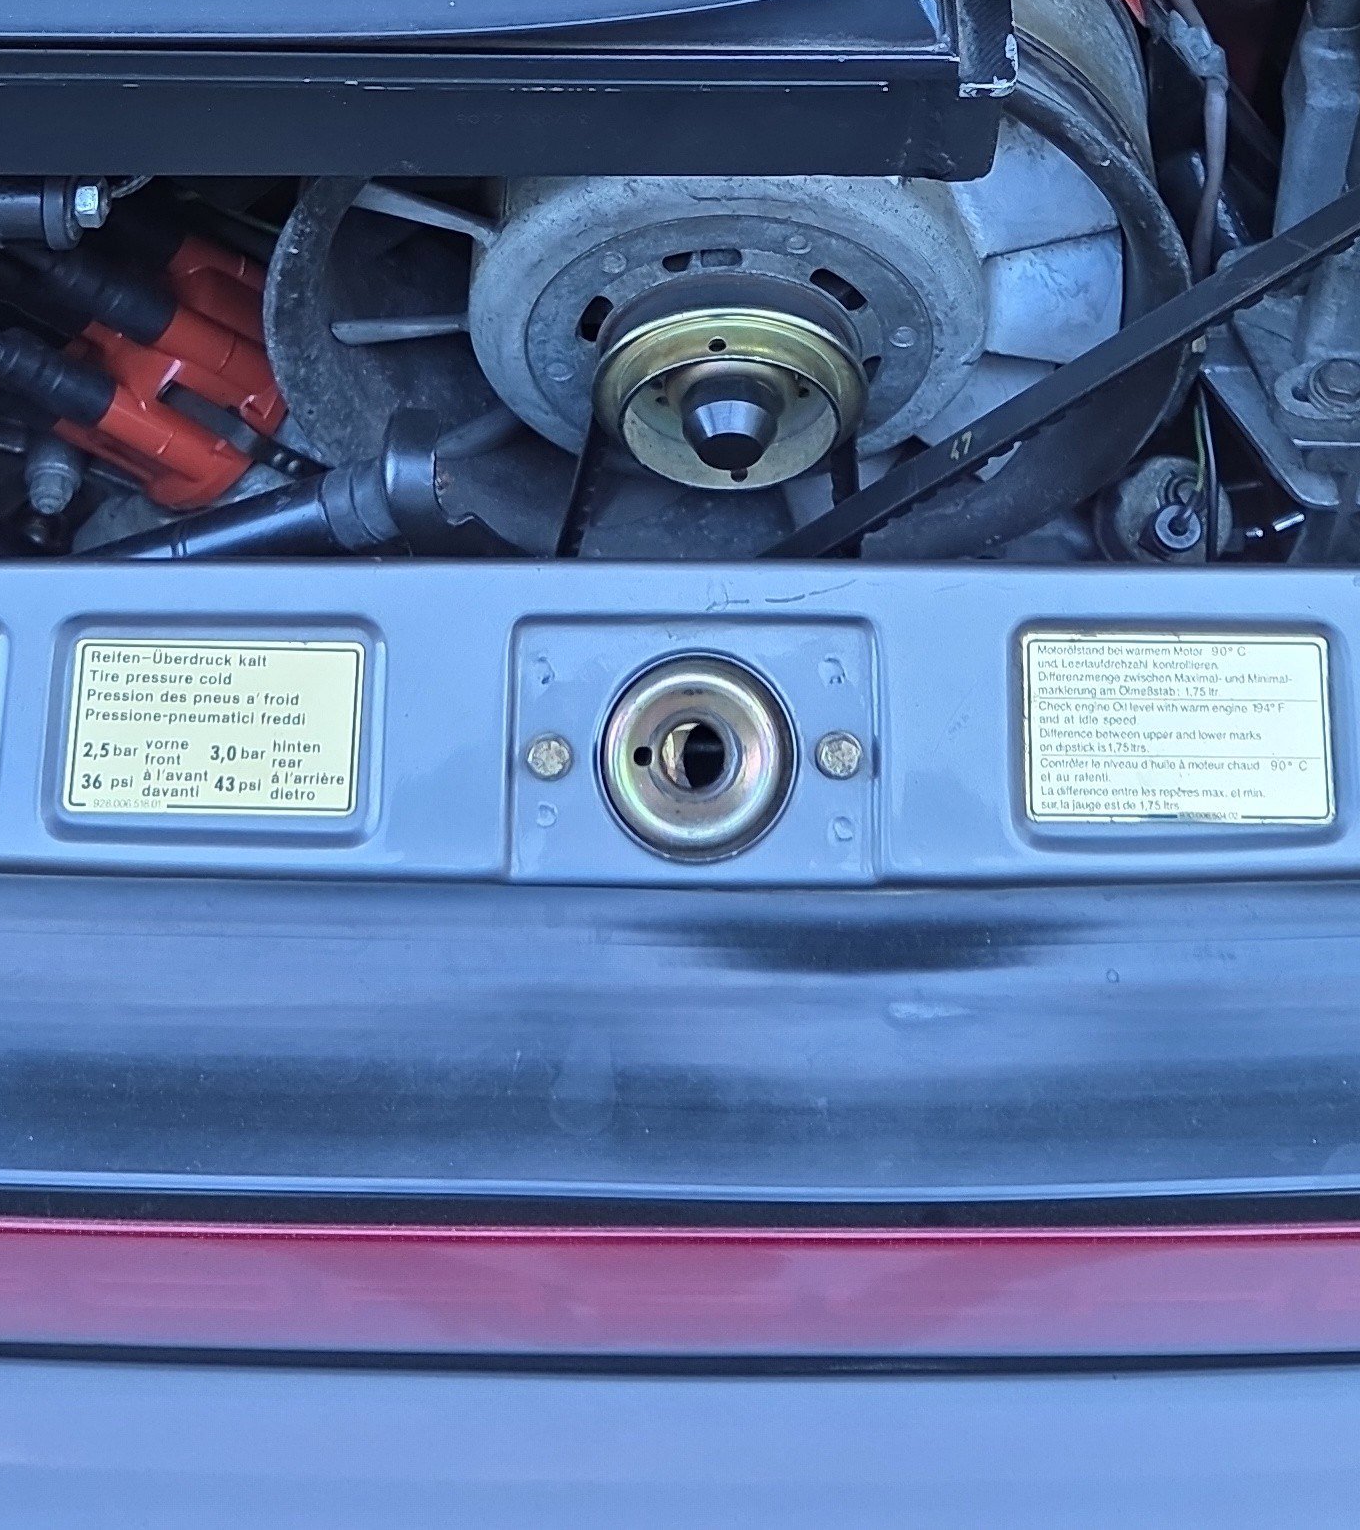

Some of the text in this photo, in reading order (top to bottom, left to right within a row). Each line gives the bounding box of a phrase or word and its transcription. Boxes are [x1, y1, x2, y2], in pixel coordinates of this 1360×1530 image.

[1037, 644, 1105, 655] Motorölstand
[1107, 645, 1123, 655] bei
[1125, 646, 1171, 656] warmem
[1173, 646, 1203, 656] Motor
[1237, 646, 1247, 657] C
[239, 654, 267, 667] kalt
[1037, 658, 1148, 670] und Leerlaufdrehzahl
[89, 669, 232, 686] Tire pressure cold
[1038, 671, 1121, 685] Differenzmenge
[1123, 672, 1172, 683] zwischen
[1225, 673, 1245, 684] und
[87, 688, 154, 702] Pression
[160, 690, 187, 703] des
[193, 693, 240, 706] pneus
[264, 692, 300, 706] froid
[1038, 685, 1097, 698] markierung
[1099, 687, 1116, 696] am
[1038, 700, 1072, 712] Check
[1074, 702, 1110, 714] engine
[1112, 701, 1128, 712] Oil
[1129, 701, 1154, 713] level
[1156, 703, 1178, 713] with
[1180, 704, 1209, 713] warm
[1211, 703, 1248, 716] engine
[1277, 702, 1285, 713] F
[85, 708, 306, 726] Pressione-pneumatici freddi
[1039, 714, 1060, 725] and
[1063, 714, 1075, 725] at
[1079, 714, 1099, 725] idle
[1039, 727, 1262, 741] Difference between upper and lower marks
[82, 741, 138, 760] 2,5 bar
[145, 739, 189, 750] vorne
[272, 739, 321, 753] hinten
[1039, 743, 1053, 753] on
[1055, 742, 1095, 754] dipstick
[1097, 742, 1107, 752] is
[144, 752, 181, 765] front
[210, 744, 266, 764] 3,0 bar
[272, 758, 303, 769] rear
[1091, 758, 1101, 769] le
[1103, 758, 1138, 770] niveau
[1188, 760, 1225, 770] moteur
[1227, 760, 1260, 771] chaud
[1298, 759, 1308, 772] C
[81, 773, 134, 790] 36 psi
[156, 769, 208, 782] l'avant
[285, 771, 345, 785] l'arrière
[1040, 771, 1051, 783] et
[1056, 772, 1070, 783] au
[141, 784, 200, 798] davanti
[214, 775, 261, 793] 43 psi
[270, 786, 315, 801] dietro
[1040, 785, 1054, 796] La
[1111, 786, 1139, 797] entre
[1140, 786, 1157, 797] les
[1230, 788, 1241, 798] et
[1060, 799, 1070, 810] la
[1072, 799, 1102, 812] jauge
[1104, 799, 1121, 811] est
[1122, 800, 1136, 810] de
